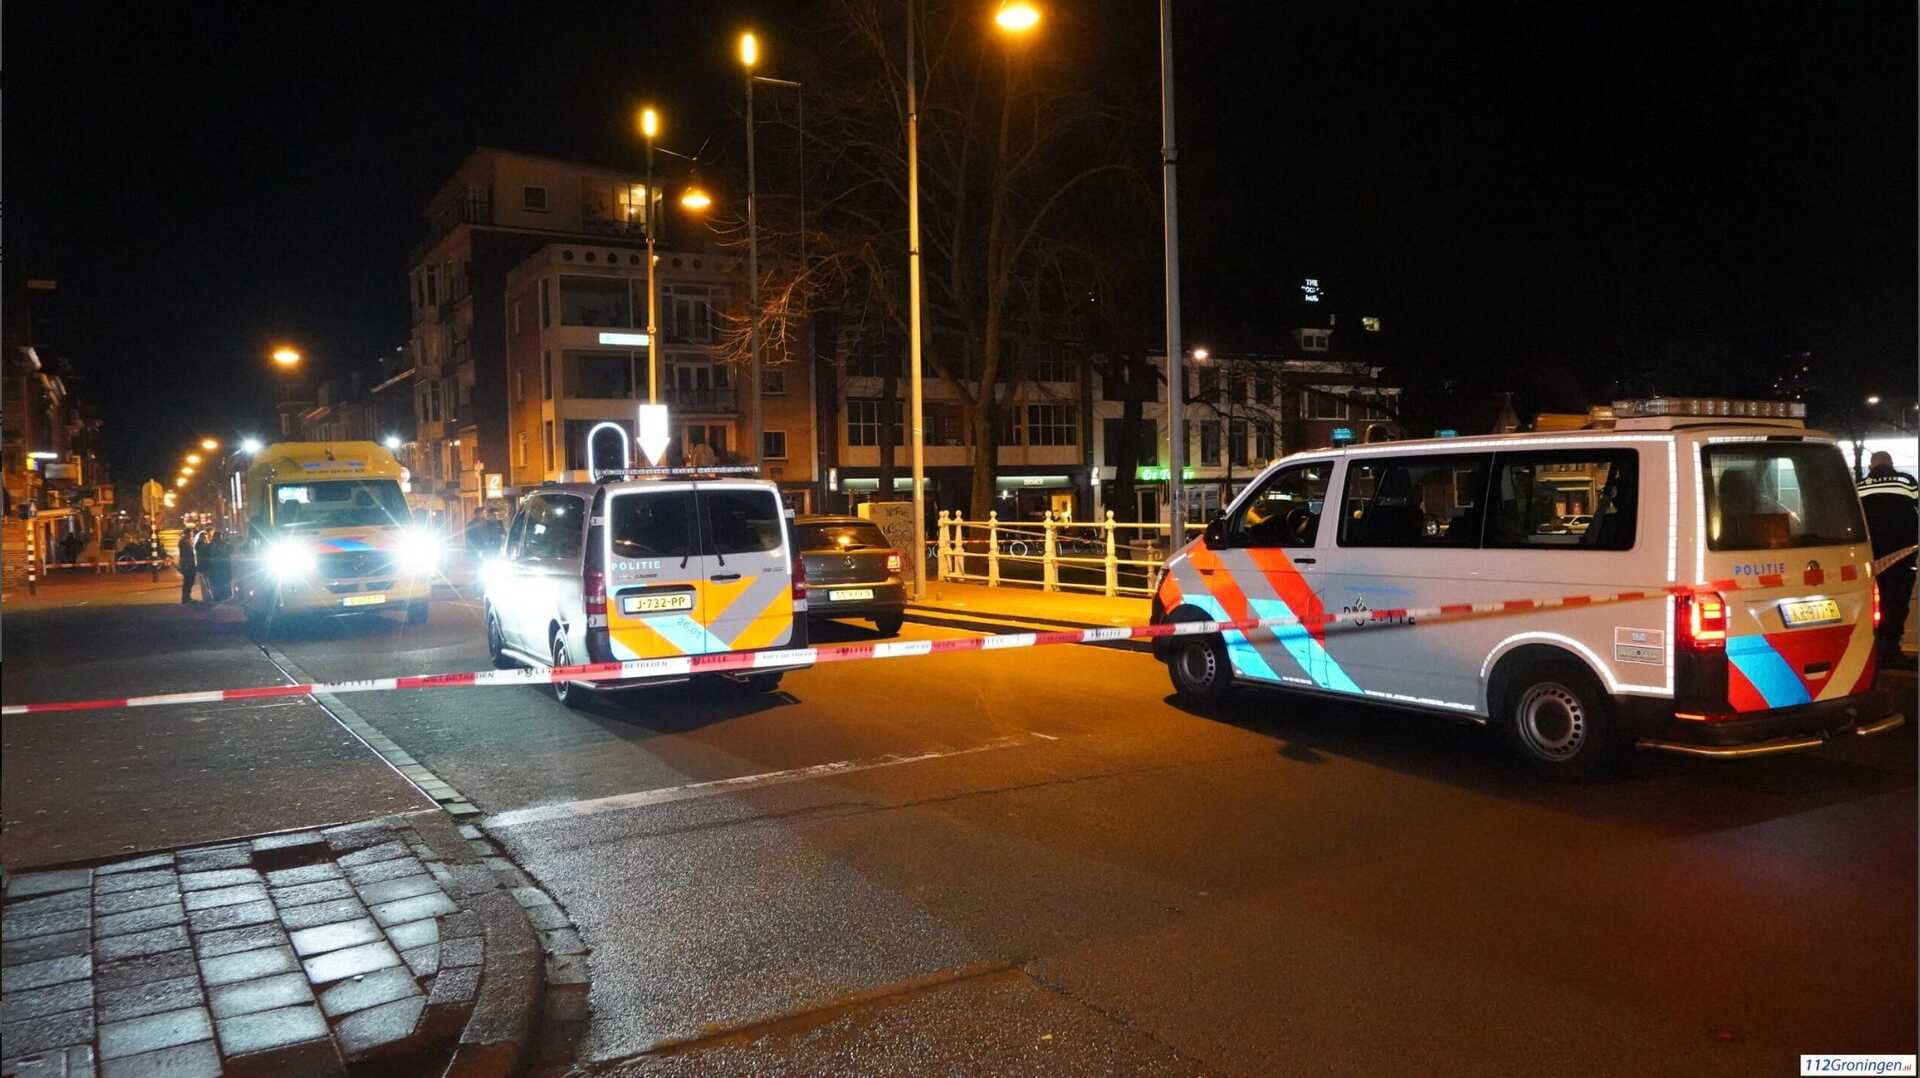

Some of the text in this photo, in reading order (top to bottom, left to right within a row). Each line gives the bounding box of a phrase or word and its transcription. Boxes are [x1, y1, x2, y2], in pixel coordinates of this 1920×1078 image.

[611, 560, 661, 571] POLITIE
[1735, 562, 1785, 576] POLITIE
[636, 596, 686, 610] J-732-PP
